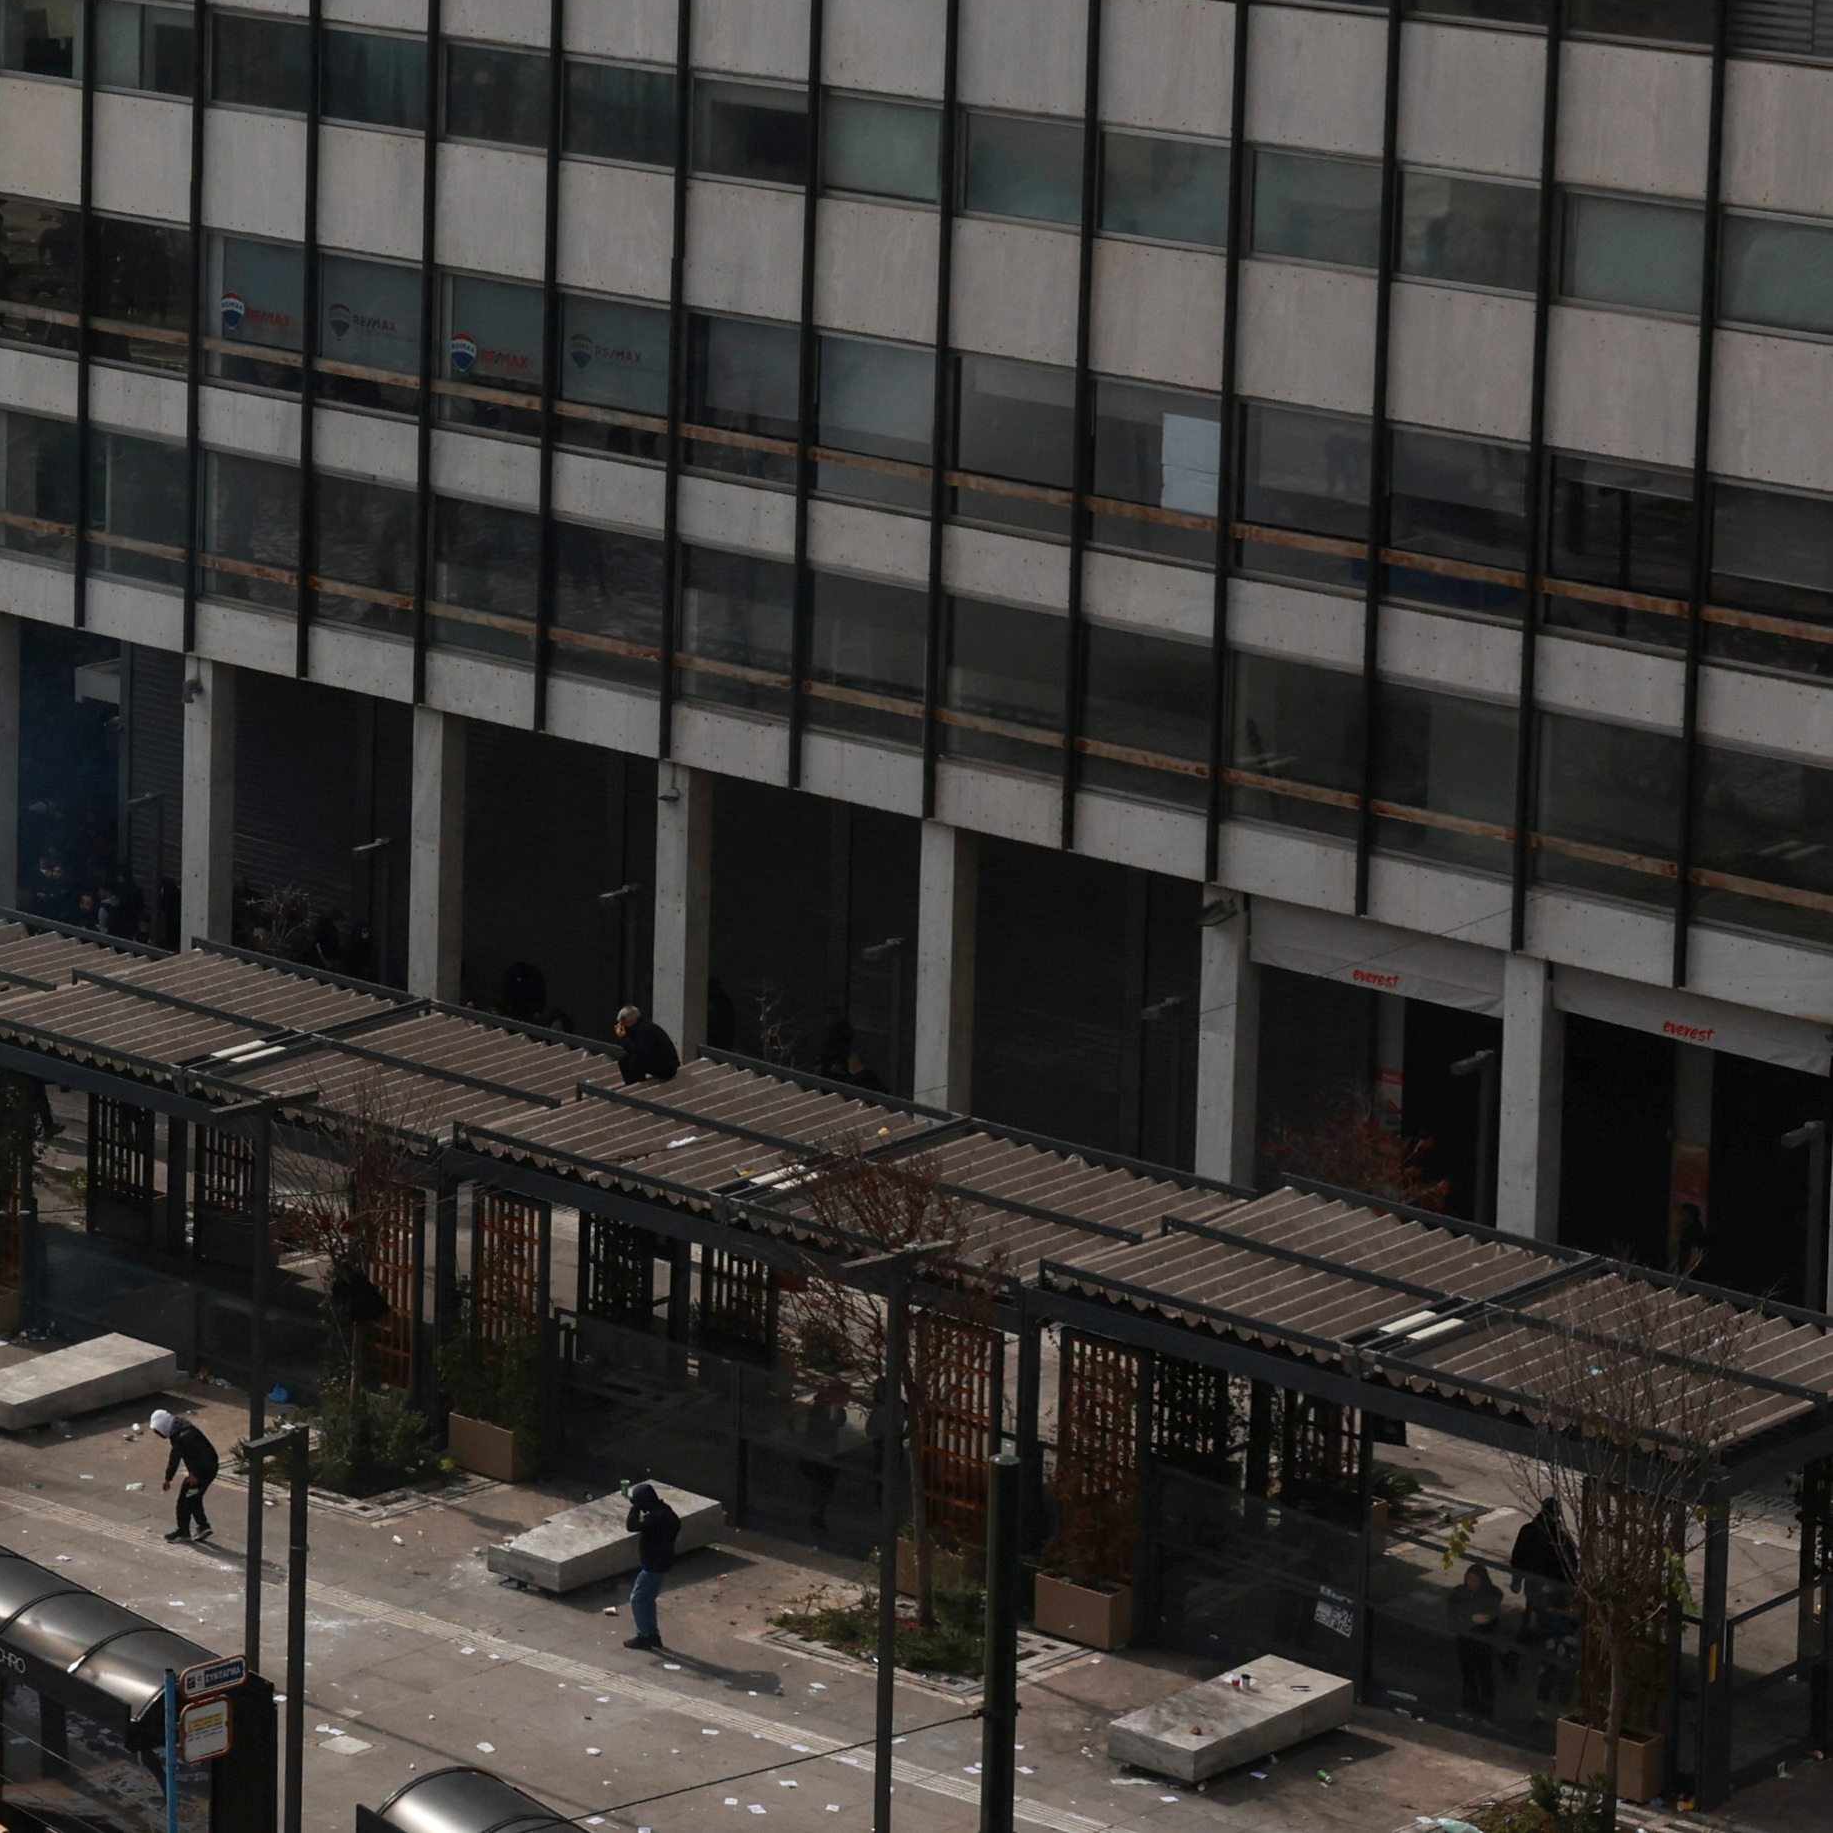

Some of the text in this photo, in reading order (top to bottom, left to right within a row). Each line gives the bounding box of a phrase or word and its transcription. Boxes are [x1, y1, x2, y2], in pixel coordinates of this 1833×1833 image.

[353, 314, 397, 333] RE/MAX
[480, 349, 528, 369] RE/MAX
[594, 345, 643, 364] RE/MAX
[1352, 969, 1400, 988] everest
[1663, 1021, 1715, 1042] everest
